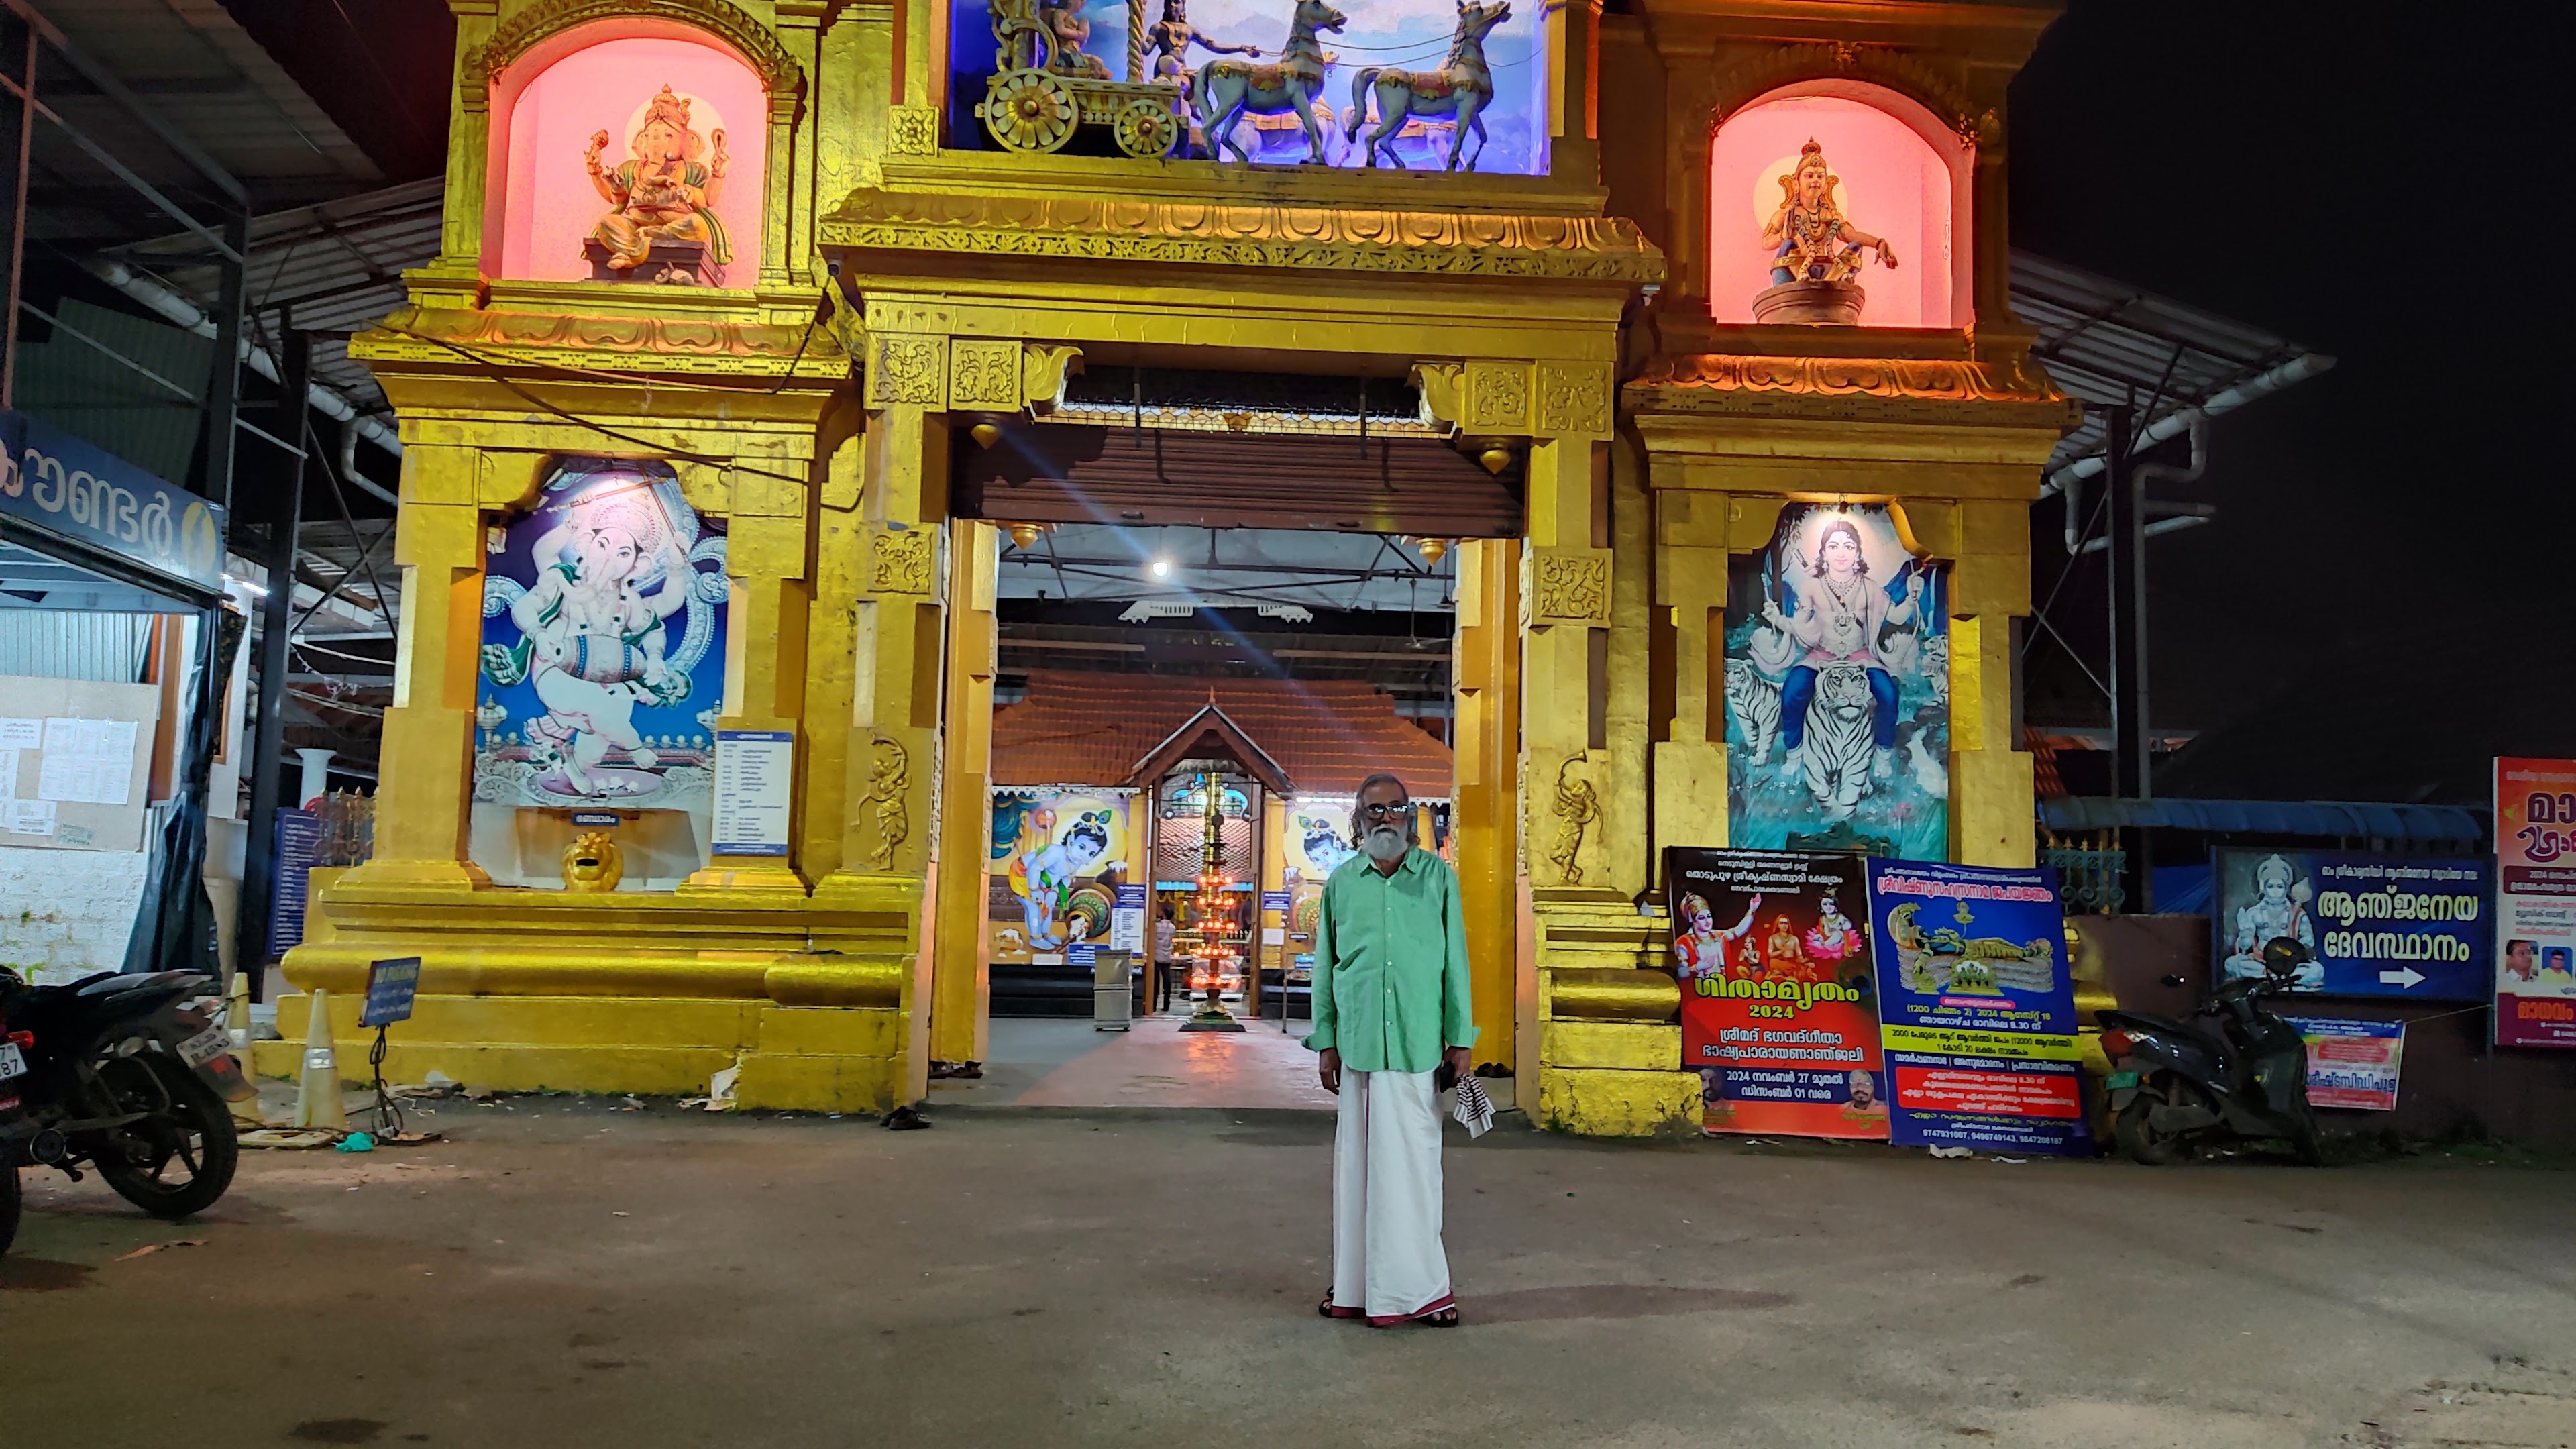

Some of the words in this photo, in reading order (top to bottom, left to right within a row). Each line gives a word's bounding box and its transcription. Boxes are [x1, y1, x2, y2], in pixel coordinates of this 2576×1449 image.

[1686, 870, 1731, 881] തൊടുപുഴ
[1733, 870, 1806, 883] ശ്രീകൃഷ്ണസ്വാമി
[1808, 874, 1843, 885] ക്ഷേത്രം
[2318, 884, 2479, 926] ആഞ്ജനേയ
[2324, 931, 2471, 962] ദേവസ്ഥാനം
[1694, 973, 1860, 1011] ഗീതാമൃതം
[1749, 1004, 1794, 1019] 2024
[1907, 1004, 1929, 1013] (1200
[1977, 1008, 1998, 1018] 2024
[1919, 1015, 1971, 1027] ഞായറാഴ്ച
[1972, 1017, 2008, 1028] രാവിലെ
[2010, 1020, 2029, 1030] 8.30
[2031, 1020, 2042, 1030] ന്
[1720, 1026, 1760, 1044] ശ്രീമദ്
[1763, 1029, 1843, 1045] ഭഗവദ്ഗീതാ
[1892, 1029, 1909, 1037] 2000
[1911, 1031, 1937, 1041] പേരുടെ
[2011, 1037, 2033, 1045] (12000
[1943, 1044, 1964, 1053] കോടി
[1727, 1070, 1750, 1081] 2024
[1752, 1071, 1796, 1083] നവംബർ
[1797, 1073, 1809, 1084] 27
[1812, 1072, 1844, 1087] മുതൽ
[1741, 1084, 1792, 1098] ഡിസംബർ
[1794, 1087, 1806, 1099] 01
[1808, 1089, 1831, 1099] വരെ
